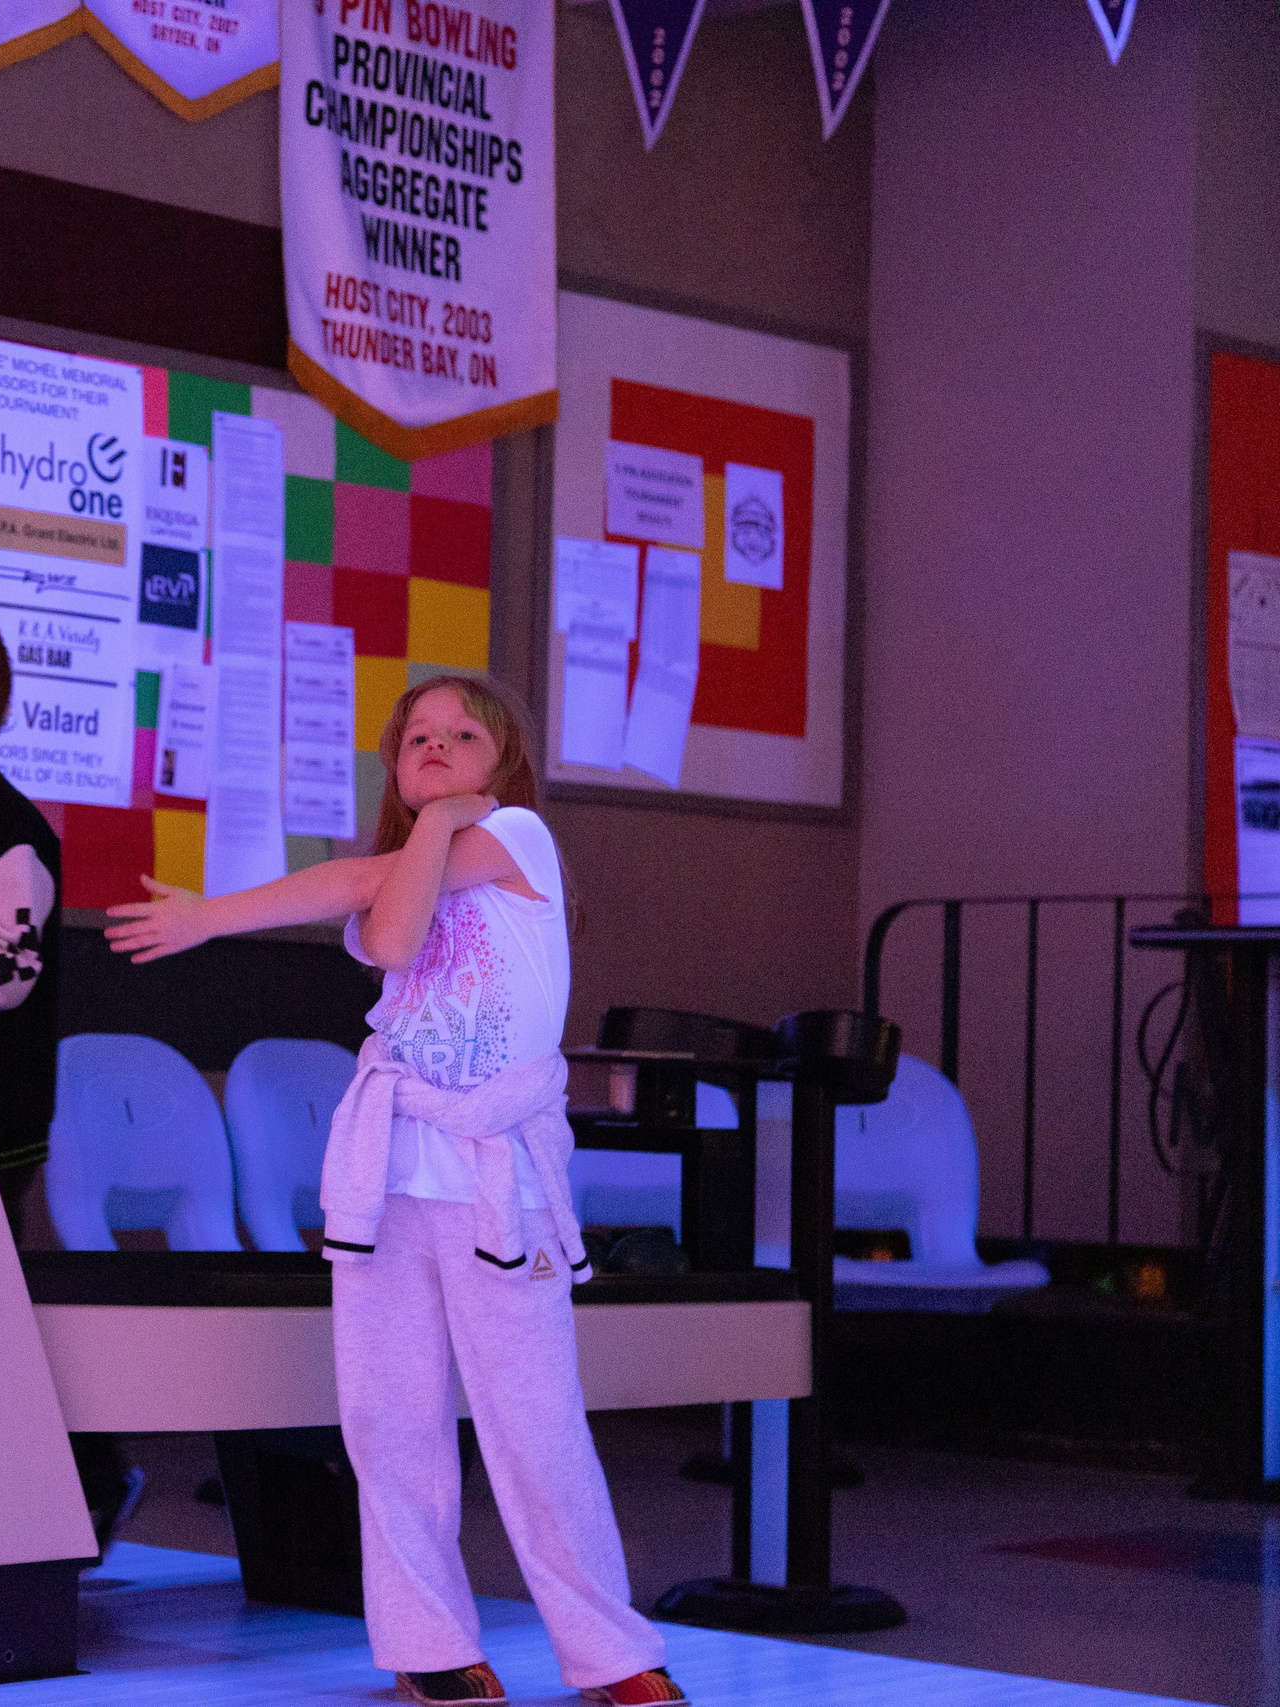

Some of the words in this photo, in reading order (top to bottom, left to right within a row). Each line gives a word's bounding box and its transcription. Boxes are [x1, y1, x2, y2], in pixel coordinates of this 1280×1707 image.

[405, 0, 517, 70] BOWLING
[333, 33, 492, 121] PROVINCIAL
[305, 79, 523, 184] CHAMPIONSHIPS
[340, 150, 489, 232] AGGREGATE
[361, 210, 462, 283] WINNER
[324, 271, 381, 318] HOST
[386, 287, 436, 335] CITY,
[442, 301, 493, 345] 2003
[11, 357, 58, 380] MICHEL
[61, 366, 128, 393] MEMORIAL
[320, 317, 415, 371] THUNDER
[421, 341, 465, 385] BAY,
[470, 351, 498, 388] ON
[41, 381, 68, 400] FOR
[71, 387, 110, 407] THEIR
[0, 432, 87, 490] hydro
[69, 488, 123, 518] one
[18, 644, 43, 665] GAS
[47, 648, 71, 668] BAR
[22, 700, 100, 736] Valard
[9, 765, 32, 782] ALL
[34, 767, 53, 784] OF
[31, 746, 68, 766] SINCE
[71, 751, 105, 768] THEY
